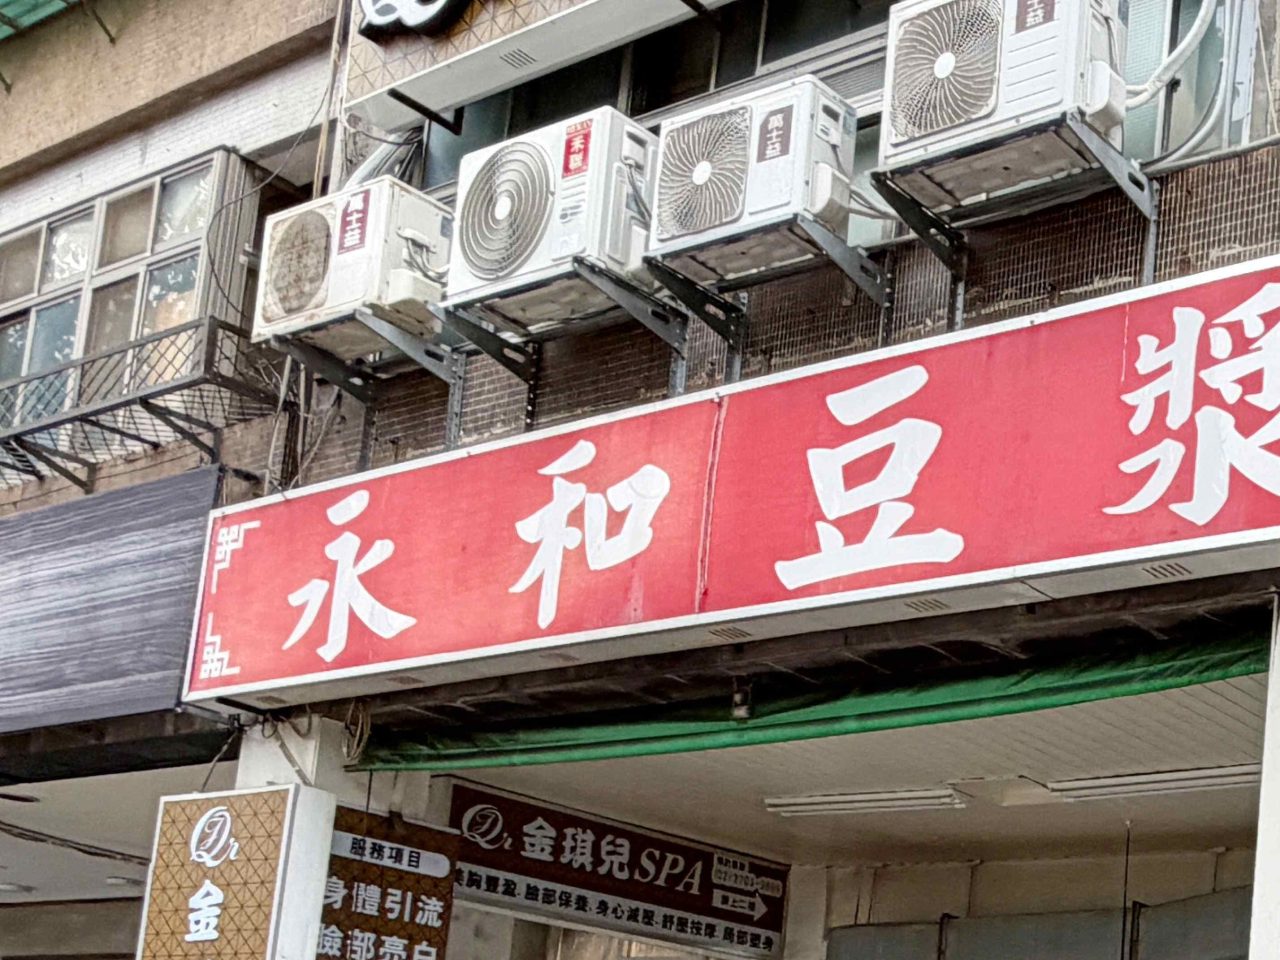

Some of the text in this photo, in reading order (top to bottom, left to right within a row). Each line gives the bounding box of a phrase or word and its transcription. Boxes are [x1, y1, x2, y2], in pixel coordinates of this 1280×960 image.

[350, 837, 421, 869] 服務項目
[323, 875, 444, 928] 身體引流
